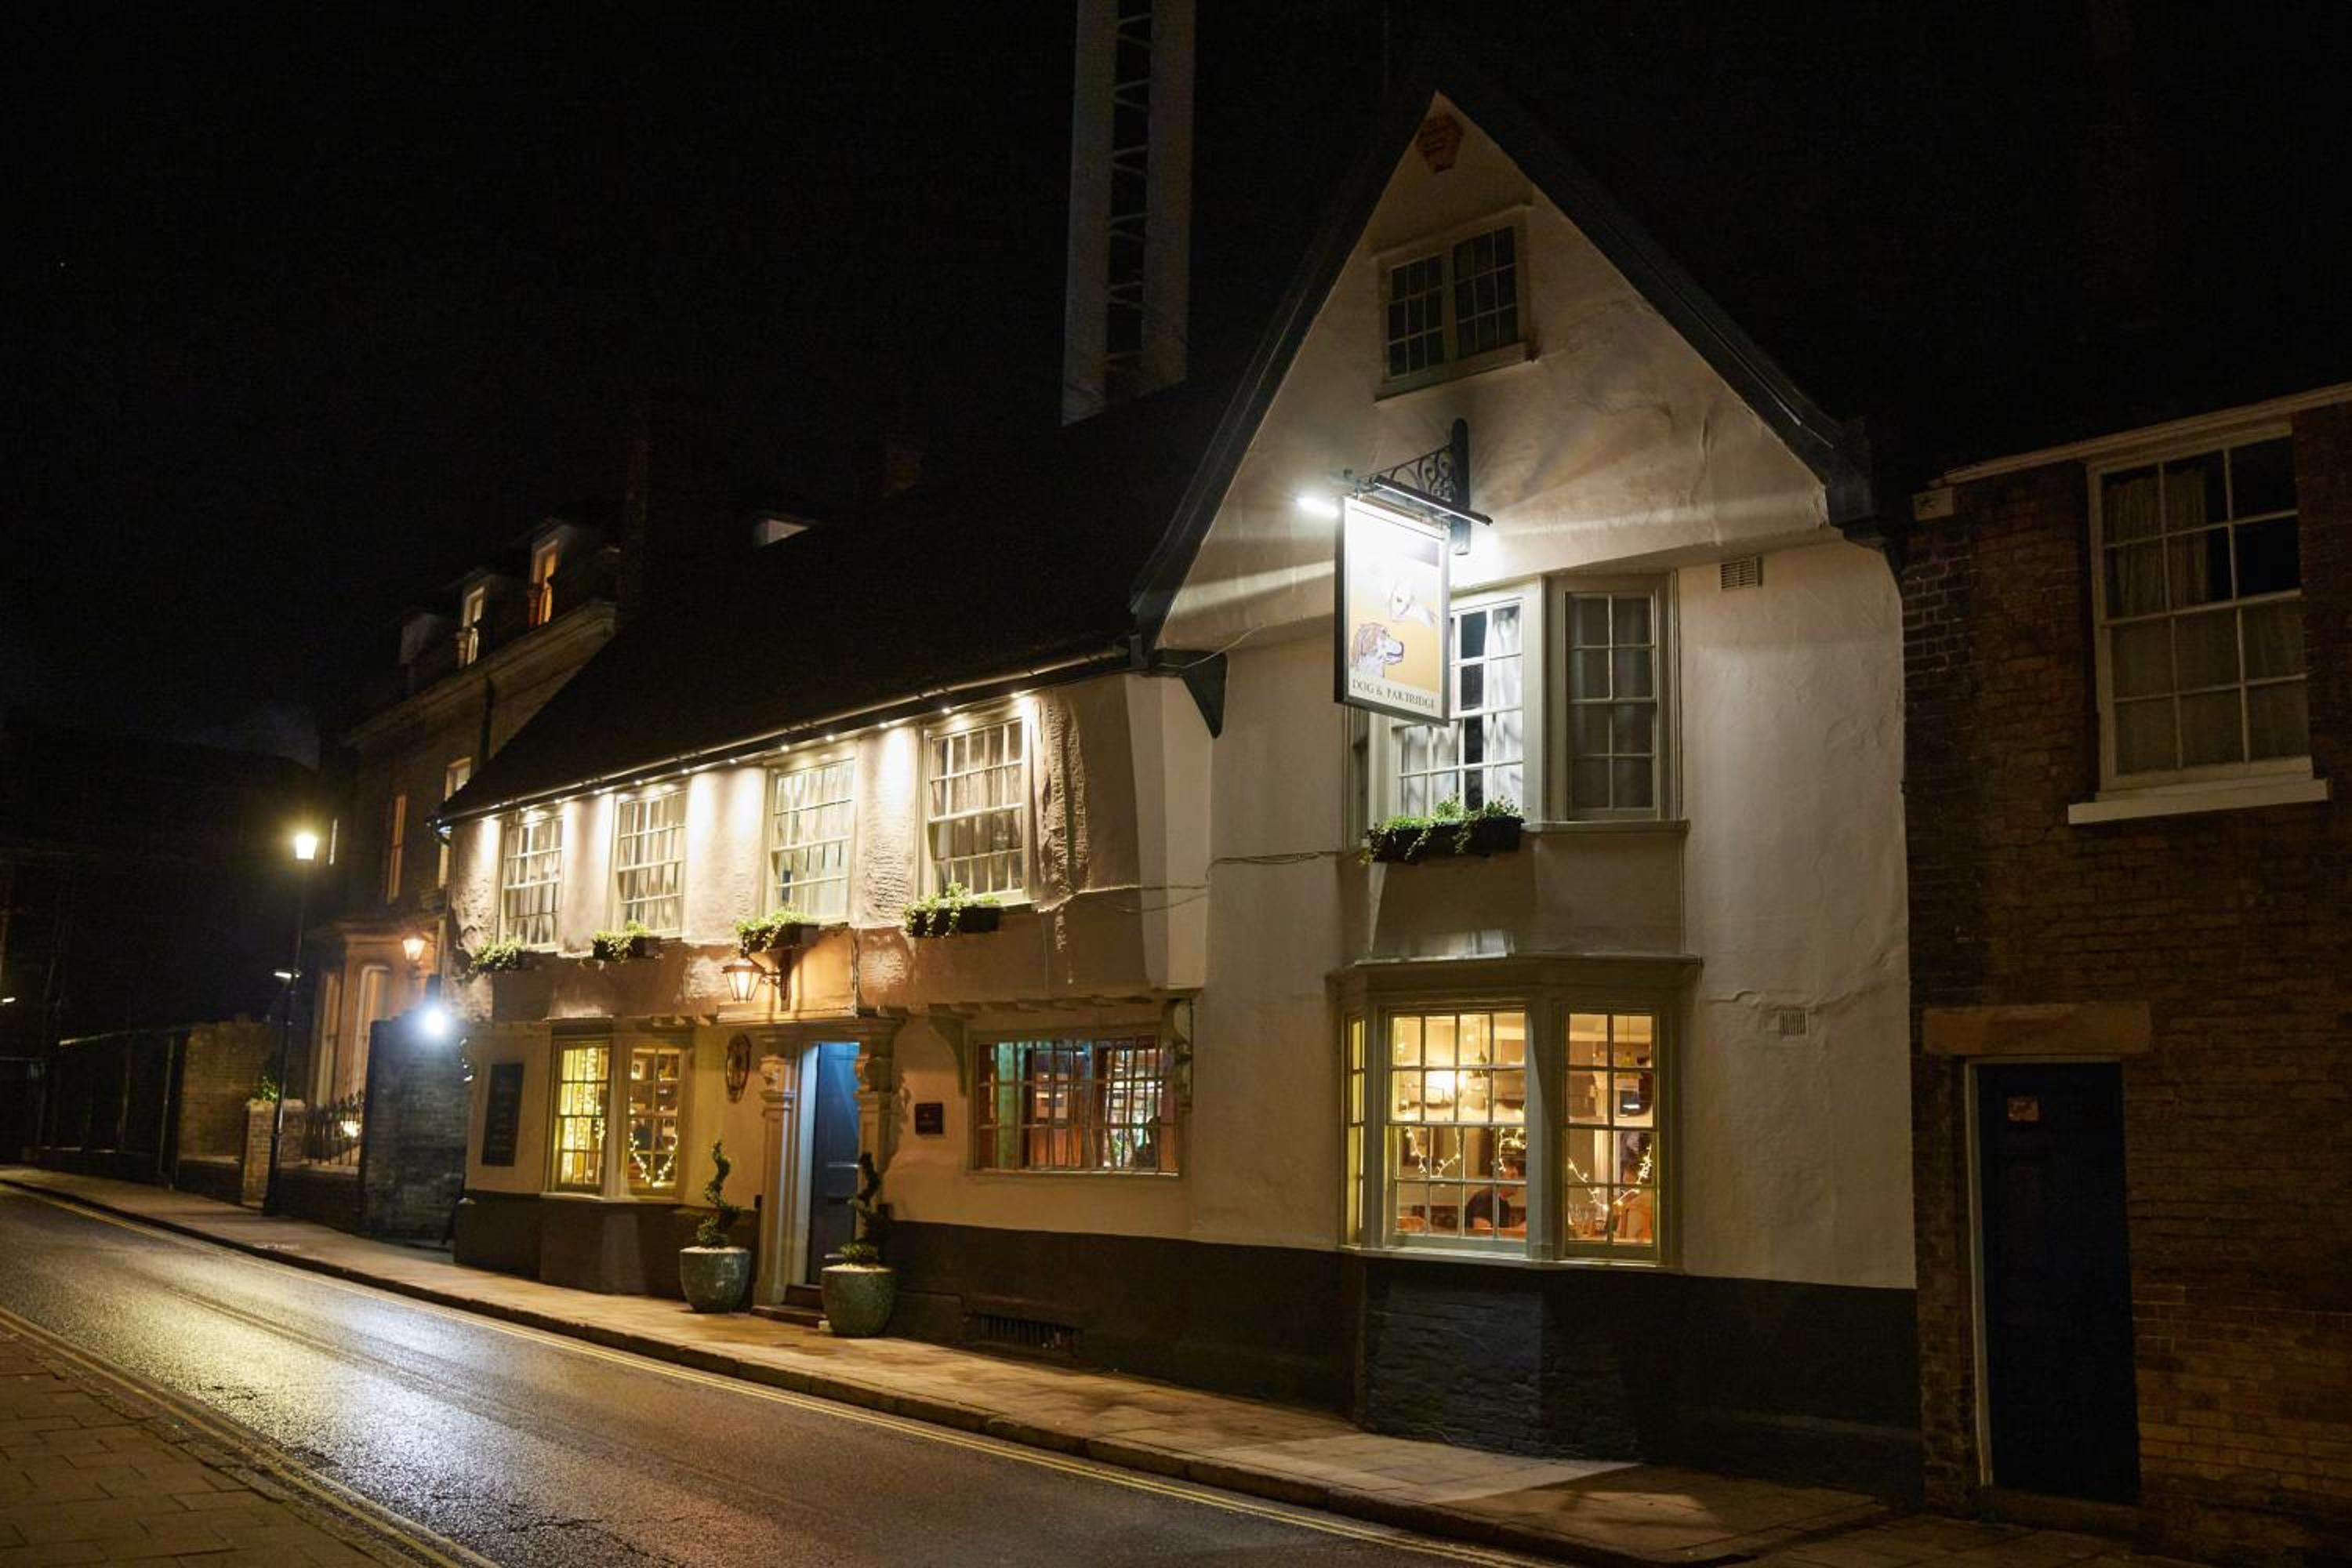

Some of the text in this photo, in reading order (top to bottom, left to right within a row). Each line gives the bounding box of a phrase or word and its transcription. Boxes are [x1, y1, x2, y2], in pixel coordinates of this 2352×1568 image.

[1352, 678, 1435, 710] DOG & PARTRIDGE
